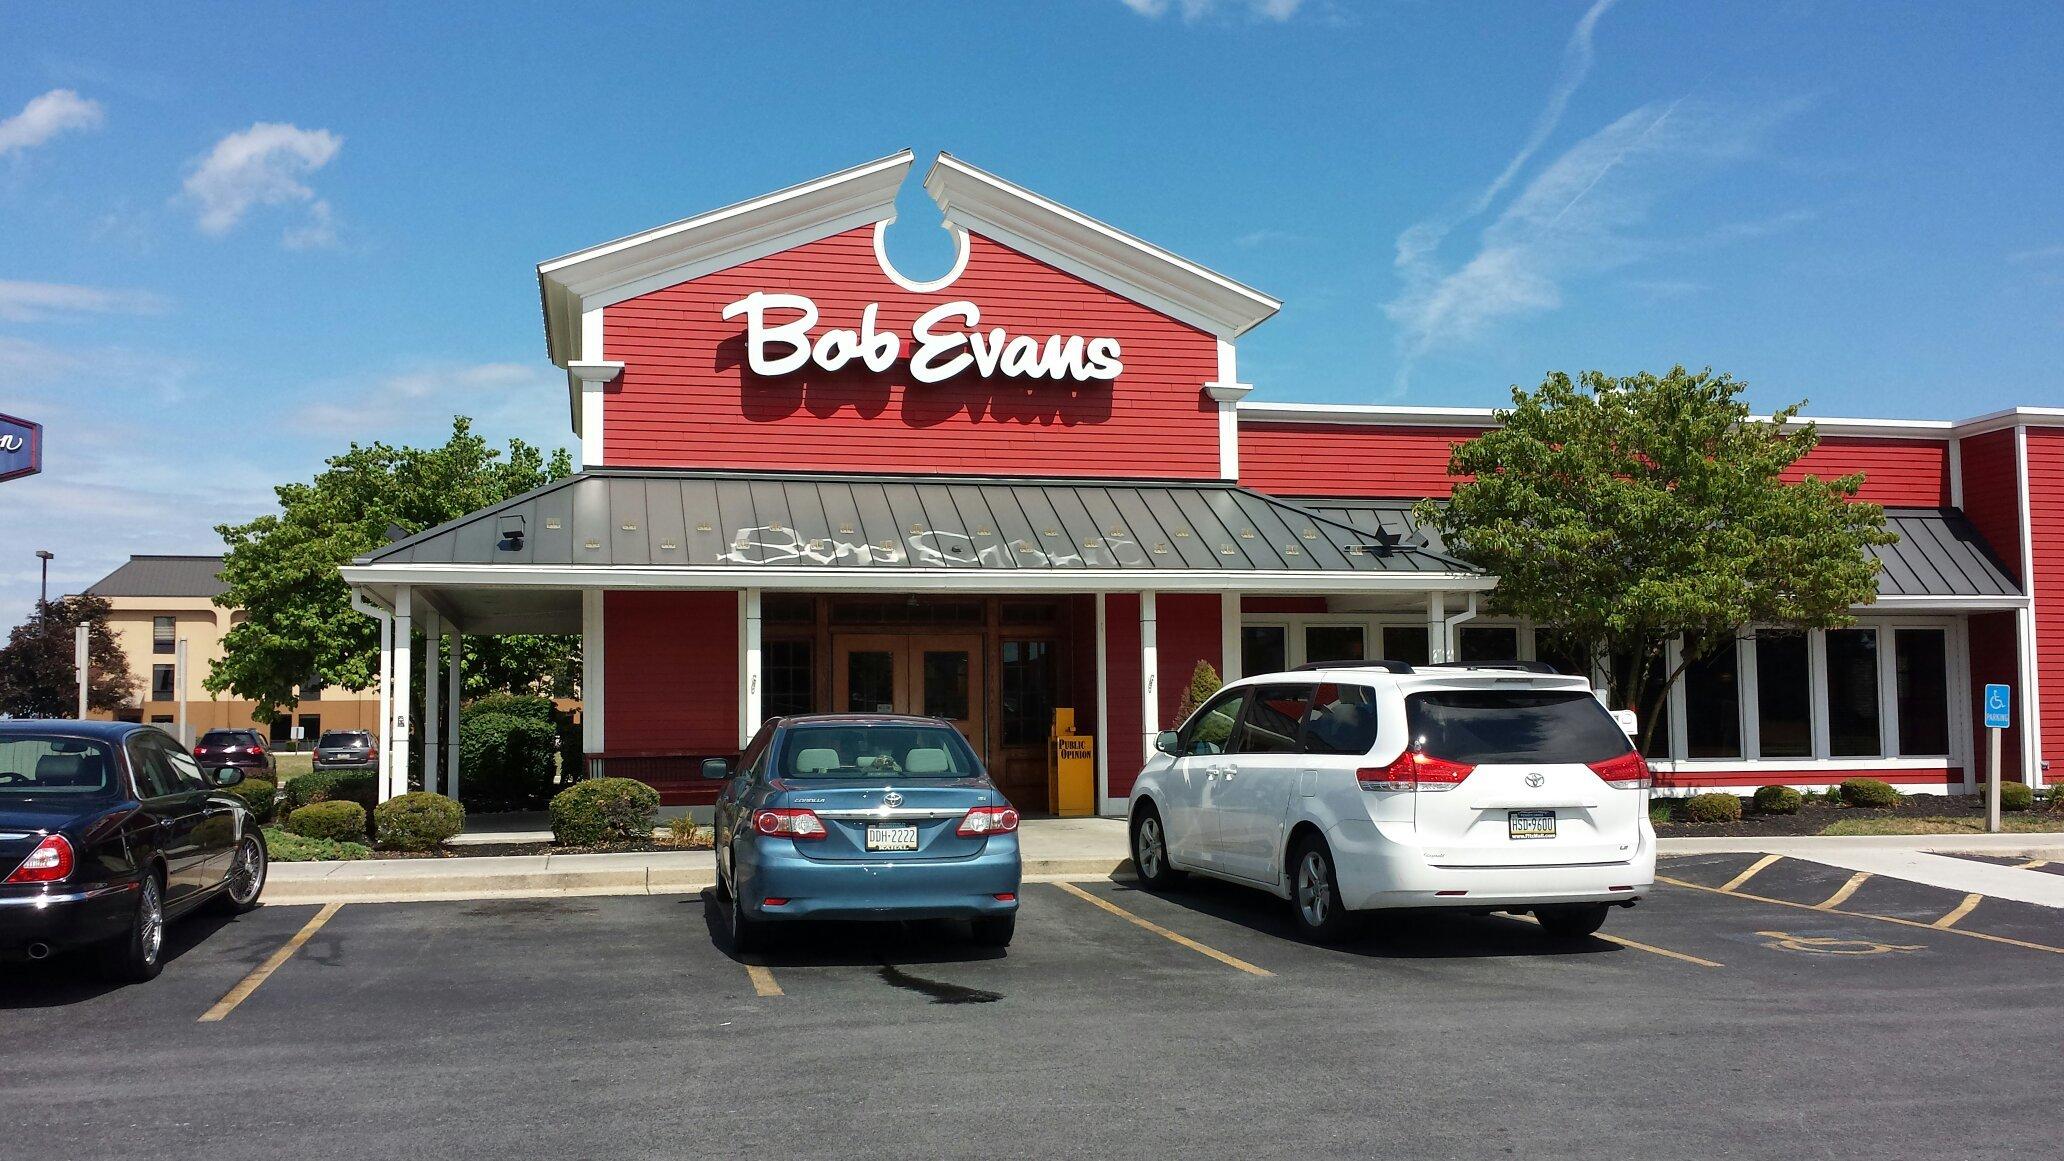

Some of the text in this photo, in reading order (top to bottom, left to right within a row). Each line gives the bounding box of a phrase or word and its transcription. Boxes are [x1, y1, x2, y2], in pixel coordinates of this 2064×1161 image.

[722, 291, 1124, 383] Bob Evans
[1058, 739, 1085, 750] PUBLIC
[1061, 749, 1092, 760] OPINION
